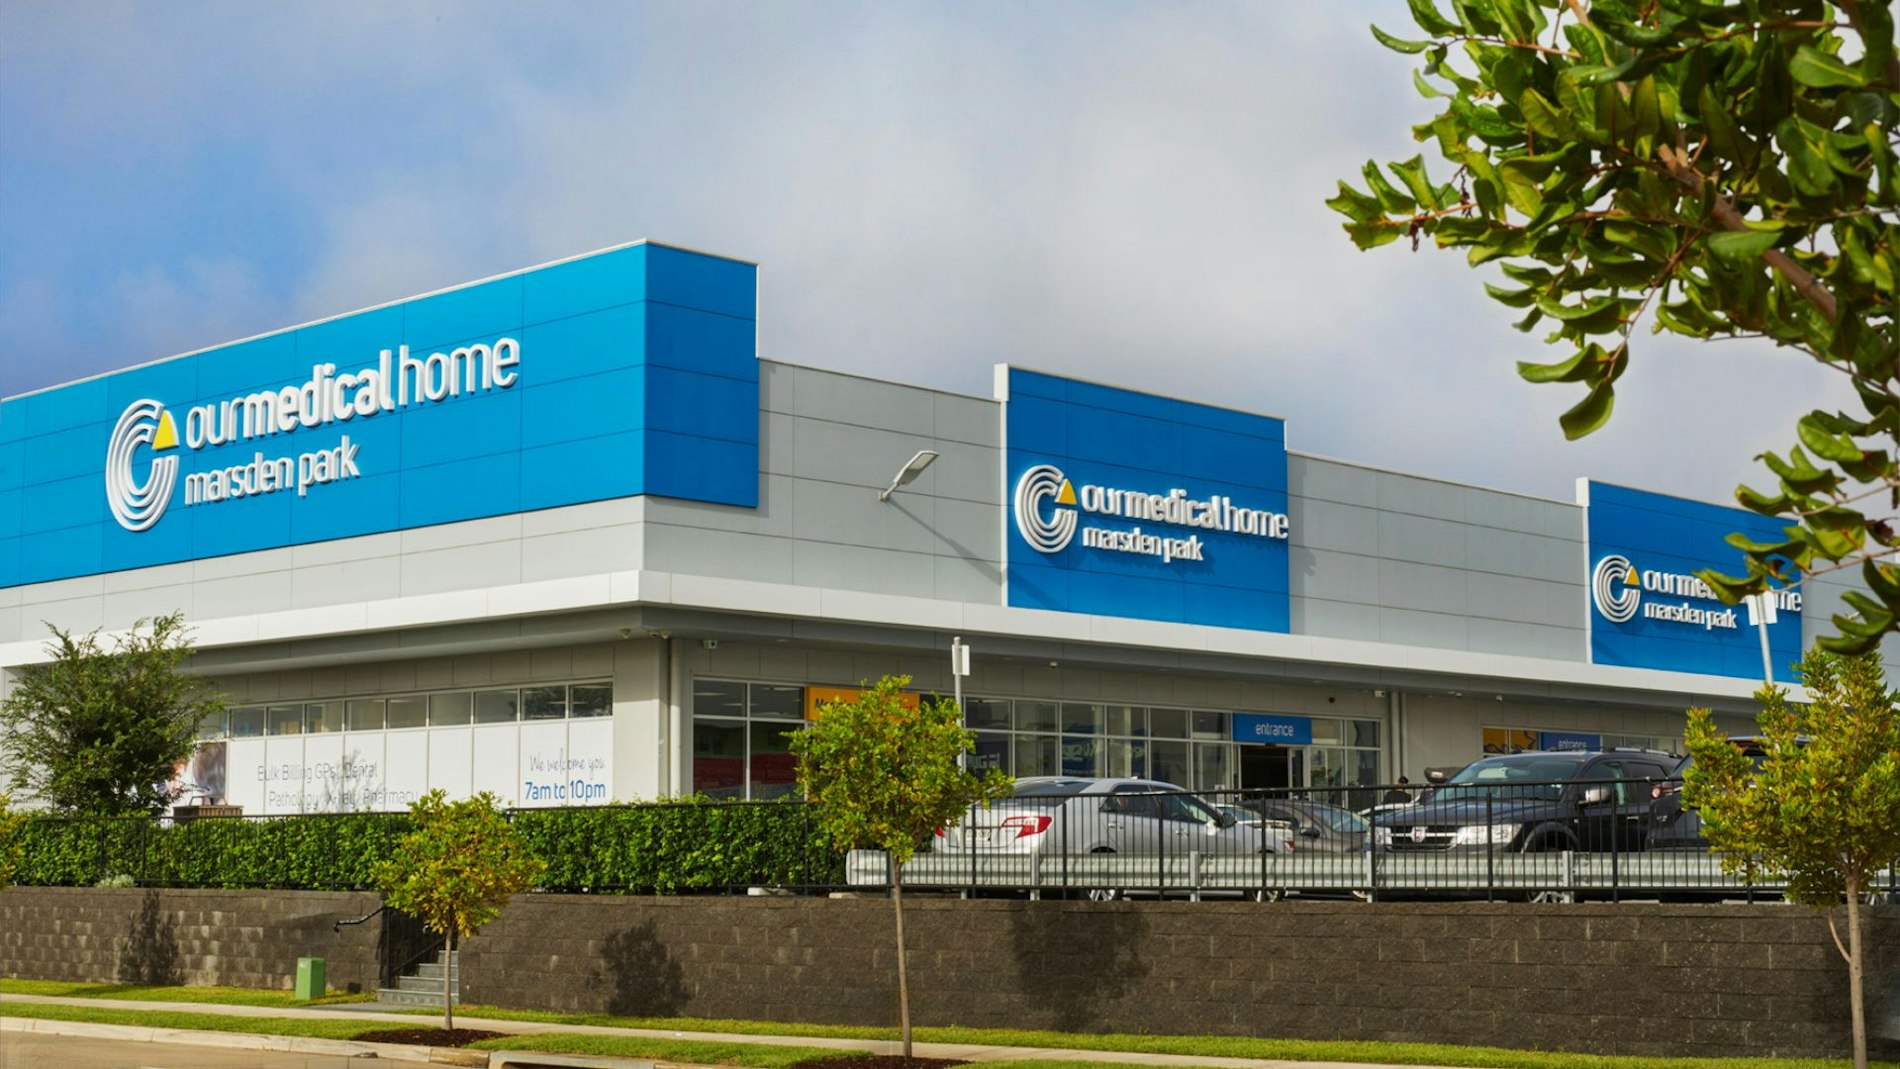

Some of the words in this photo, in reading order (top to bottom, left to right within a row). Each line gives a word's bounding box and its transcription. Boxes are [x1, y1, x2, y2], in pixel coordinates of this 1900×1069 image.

[184, 452, 293, 506] marsden
[298, 435, 361, 497] park
[1082, 526, 1162, 556] marsden
[1163, 535, 1205, 563] park
[1643, 602, 1705, 625] marsden
[1705, 608, 1738, 630] park
[1255, 722, 1294, 737] entrance
[257, 763, 279, 782] Bulk
[281, 763, 313, 784] Billing
[529, 751, 544, 771] We
[546, 747, 585, 775] welcome
[588, 757, 606, 781] you
[269, 790, 319, 811] Pathology
[525, 781, 552, 800] 7am
[553, 782, 567, 800] to
[569, 779, 606, 803] 10pm
